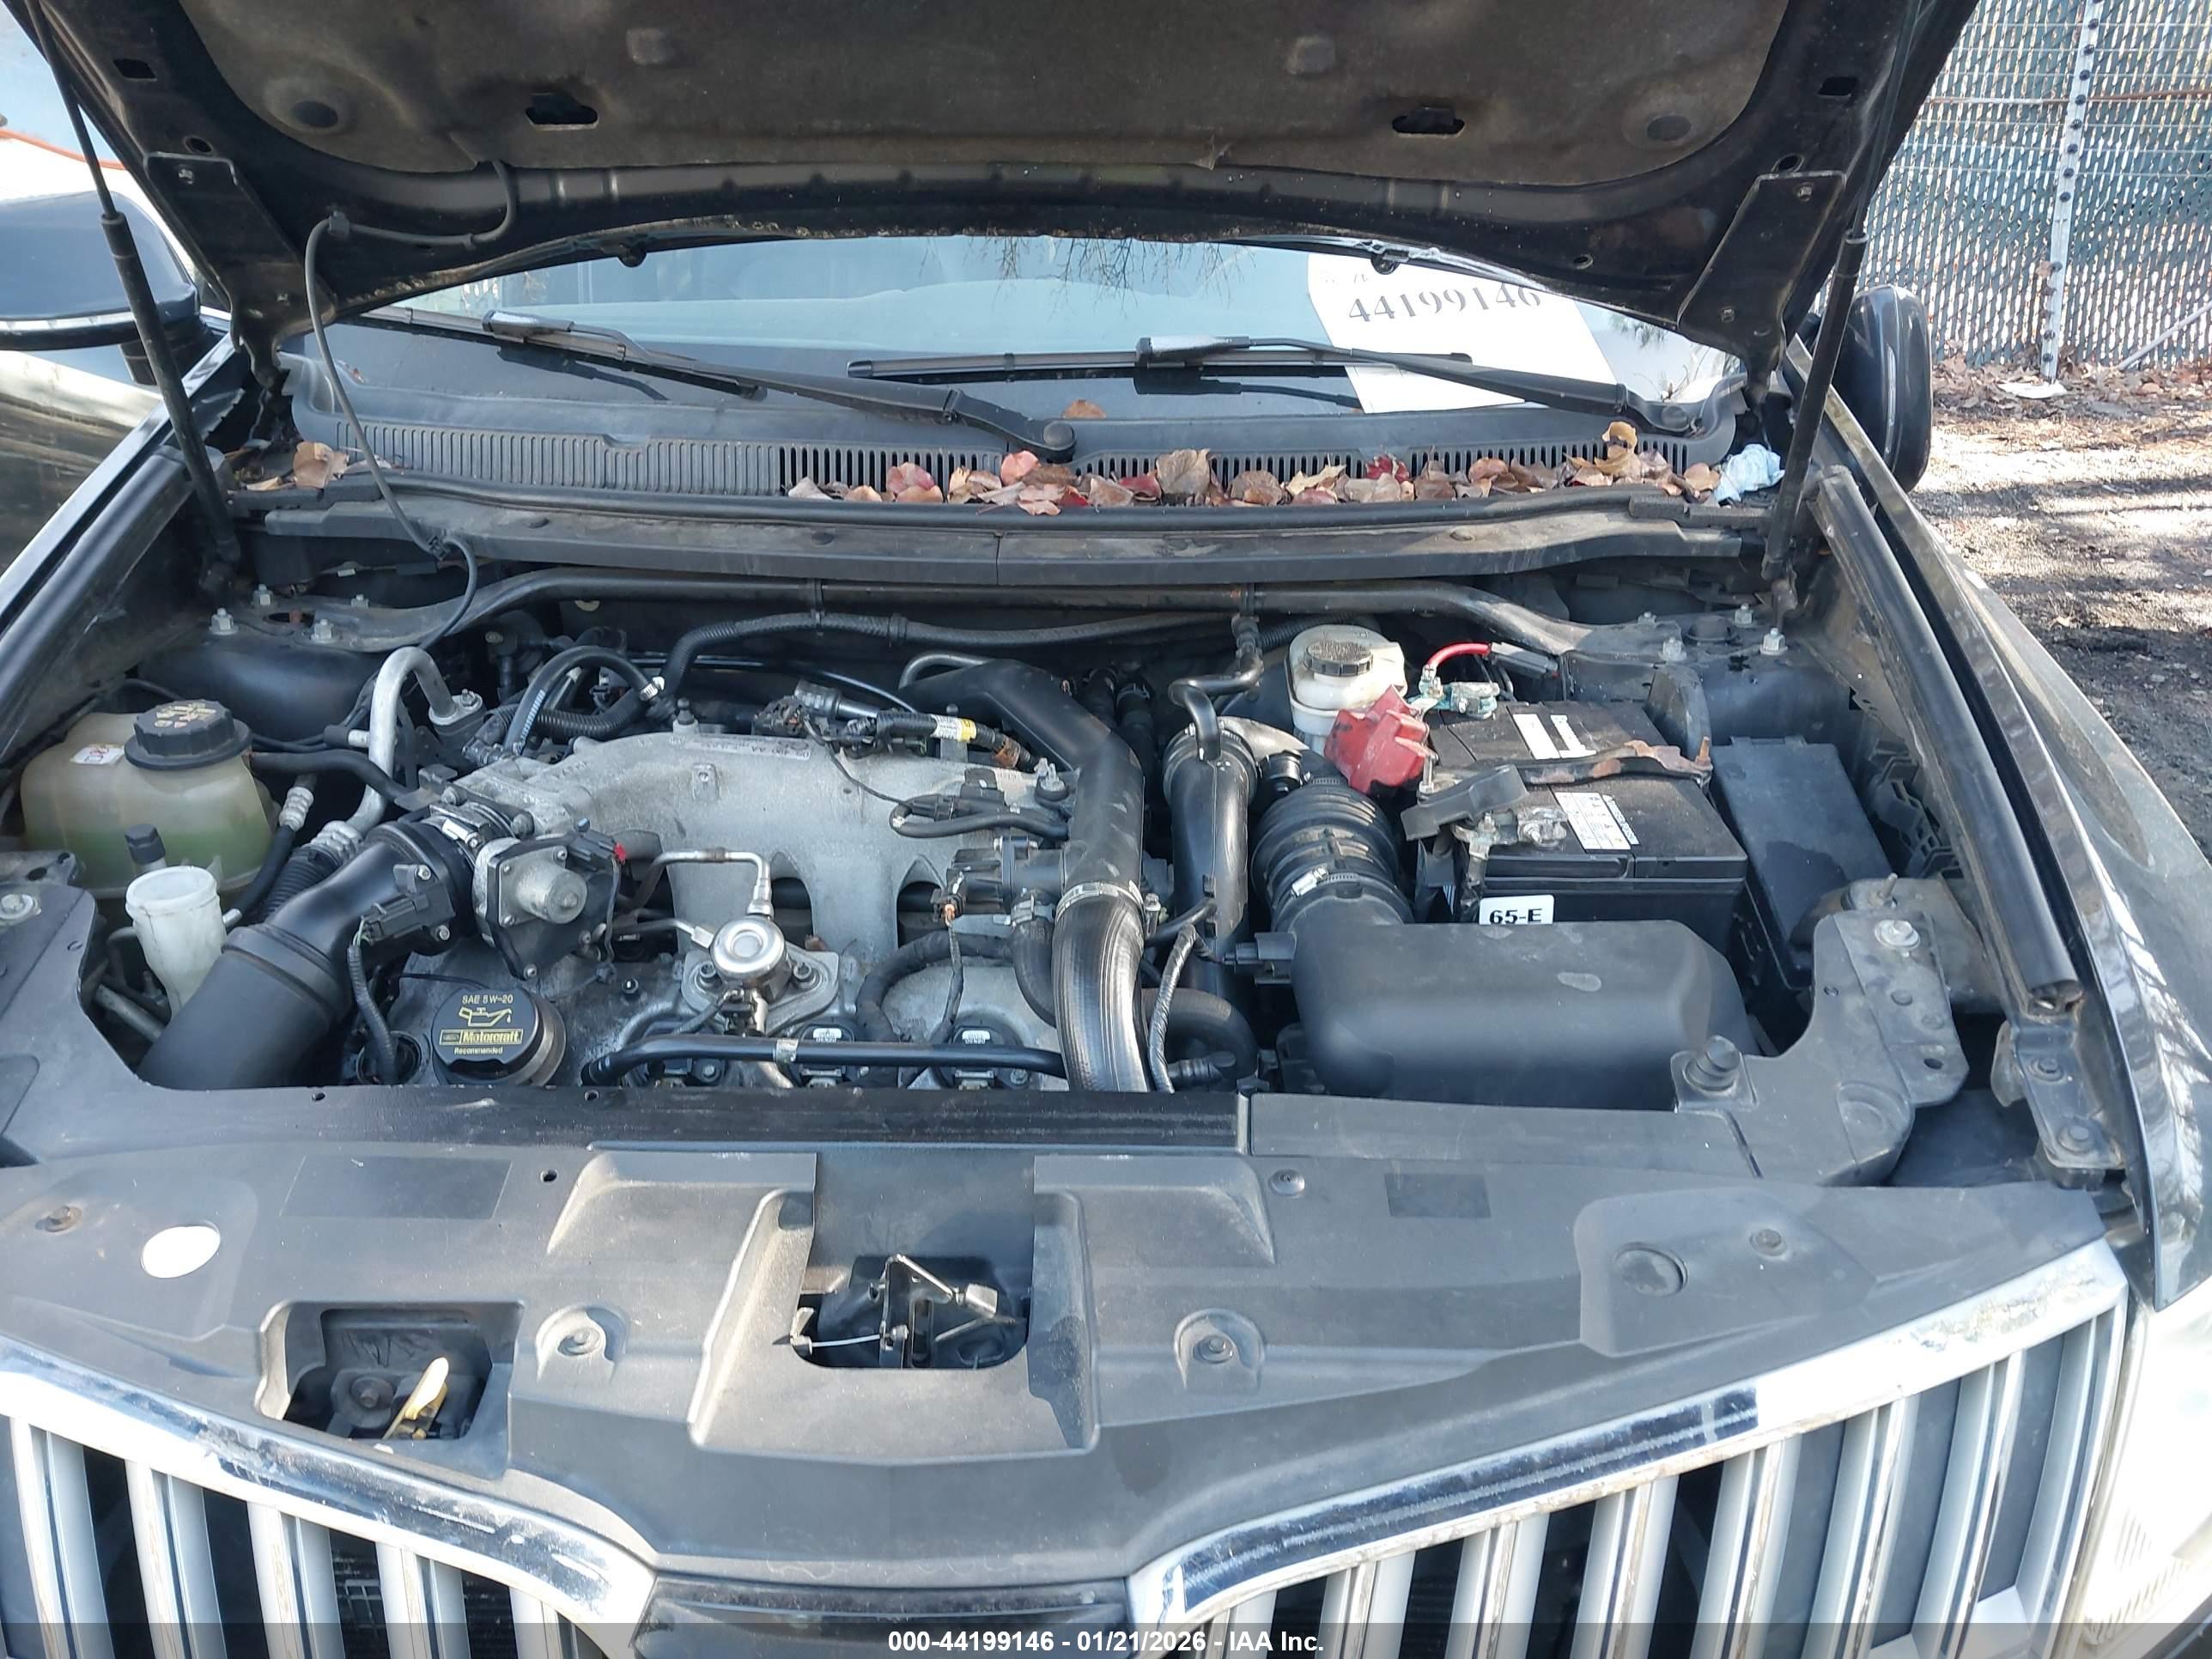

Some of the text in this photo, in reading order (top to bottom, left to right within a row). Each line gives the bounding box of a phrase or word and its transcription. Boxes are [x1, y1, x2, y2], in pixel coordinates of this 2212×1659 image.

[1349, 283, 1541, 322] 44199146
[1489, 908, 1543, 924] 65-E
[462, 994, 481, 1004] SAE
[462, 1030, 521, 1044] Motorcraft
[454, 1046, 503, 1055] Recommended
